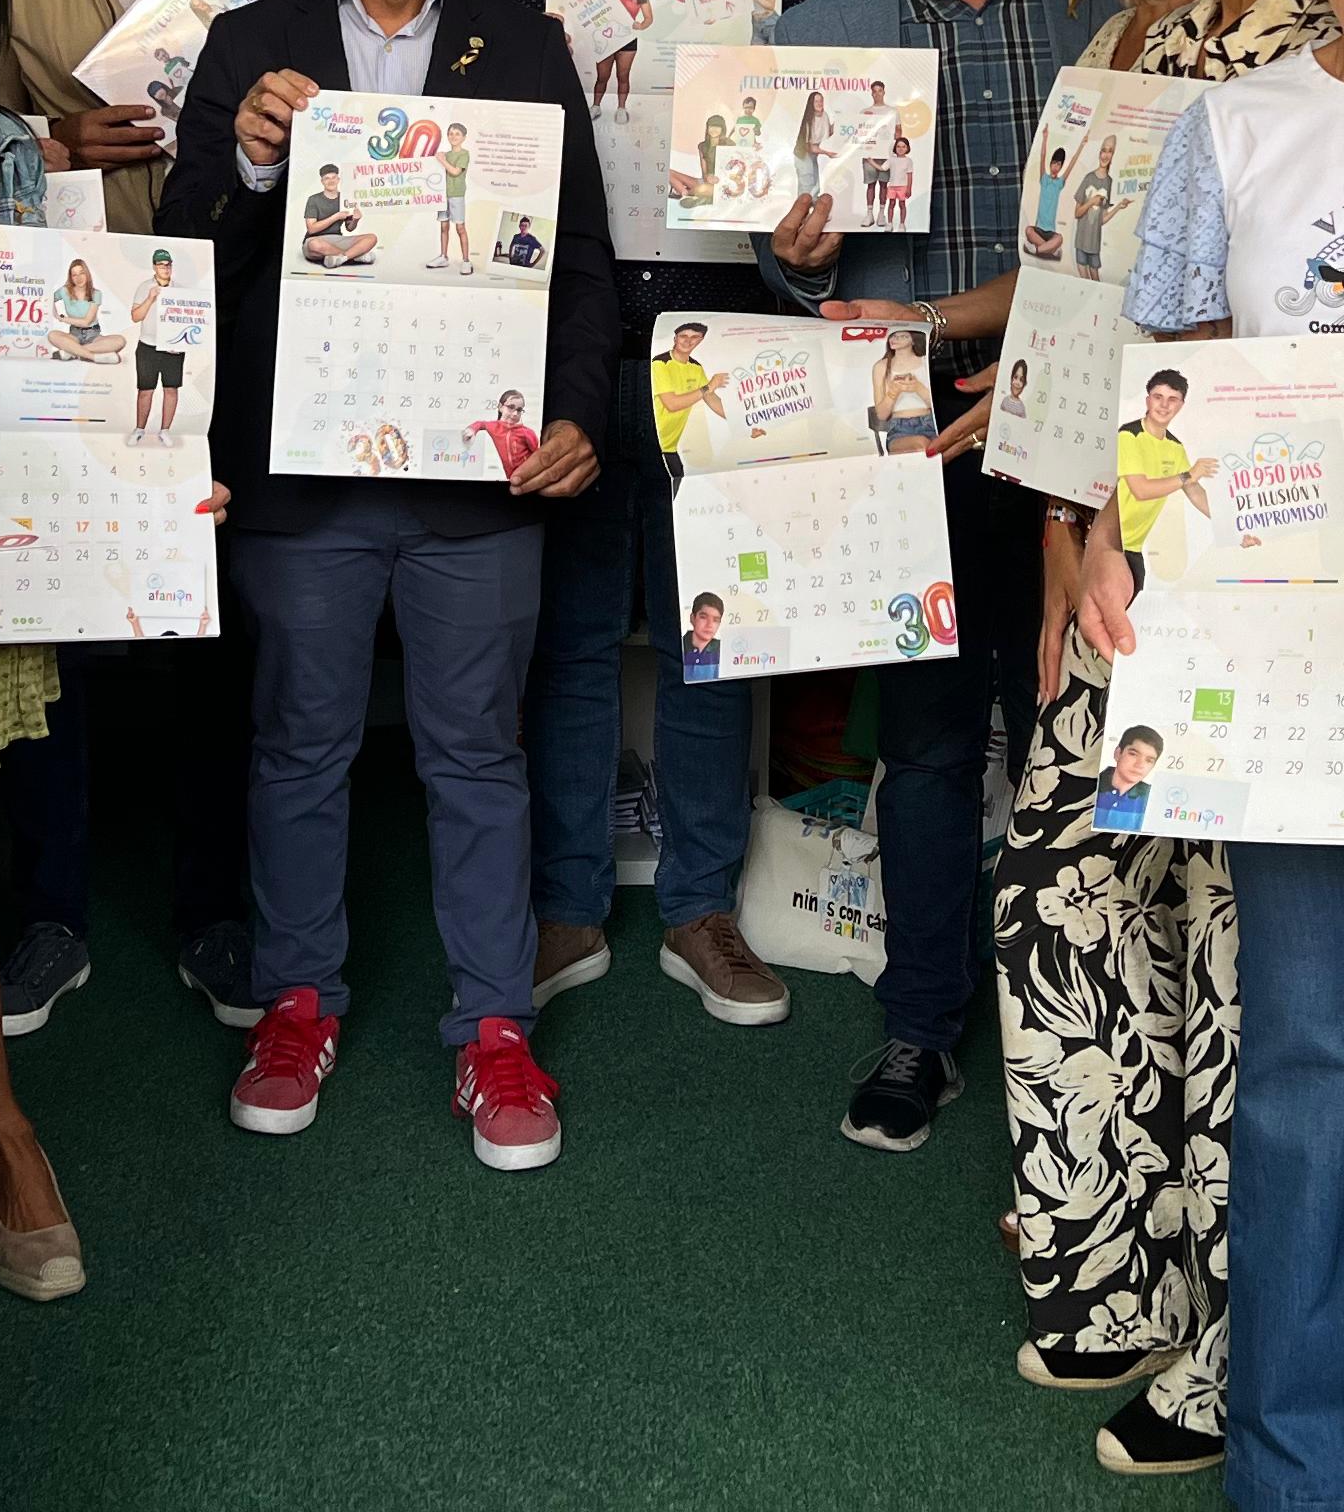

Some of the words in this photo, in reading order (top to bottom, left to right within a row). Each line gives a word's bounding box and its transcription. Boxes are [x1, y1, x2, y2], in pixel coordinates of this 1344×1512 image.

[331, 112, 364, 125] Añazos
[328, 122, 362, 135] Ilusión
[378, 161, 423, 174] GRANDES!
[370, 175, 385, 187] LOS
[353, 186, 422, 199] COLABORADORES
[375, 198, 403, 208] ayudan
[16, 286, 43, 297] ACTIVO
[4, 298, 43, 324] 126
[783, 366, 808, 381] DÍAS
[743, 395, 758, 409] DE
[761, 386, 795, 406] ILUSIÓN
[799, 384, 806, 397] Y
[745, 397, 814, 427] COMPROMISO!
[433, 451, 476, 468] afanion
[1290, 462, 1323, 482] DÍAS
[1236, 494, 1255, 511] DE
[1258, 485, 1310, 509] ILUSIÓN
[1312, 484, 1320, 500] Y
[1236, 503, 1329, 532] COMPROMISO!
[76, 521, 89, 534] 17
[106, 521, 119, 534] 18
[148, 590, 192, 607] afanion
[887, 581, 957, 657] 30
[1308, 629, 1313, 641] 1
[732, 653, 776, 669] afanion
[1178, 690, 1192, 703] 12
[1218, 691, 1231, 705] 13
[1257, 693, 1270, 706] 14
[1296, 694, 1309, 707] 15
[1166, 756, 1184, 770] 26
[1207, 758, 1224, 772] 27
[1246, 760, 1263, 774] 28
[1286, 761, 1303, 775] 29
[1325, 762, 1343, 775] 30
[1164, 807, 1224, 833] afanion
[839, 904, 862, 925] con
[824, 918, 869, 943] aanion
